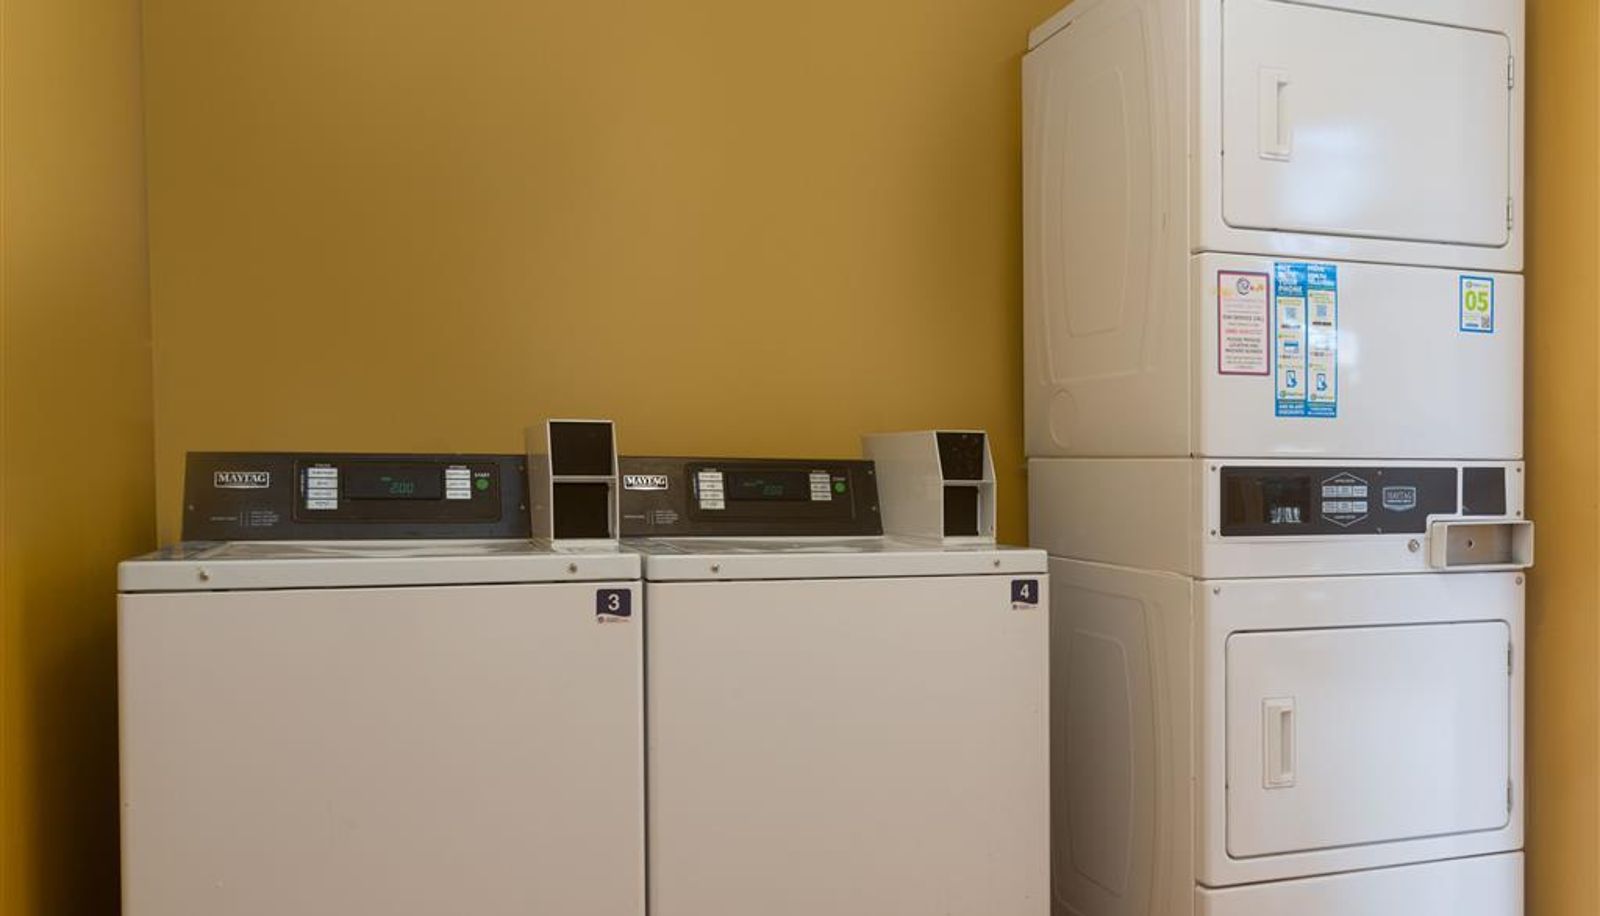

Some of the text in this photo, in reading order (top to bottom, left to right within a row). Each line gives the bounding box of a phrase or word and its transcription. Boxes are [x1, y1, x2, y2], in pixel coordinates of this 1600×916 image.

[1465, 291, 1489, 311] 05
[218, 473, 267, 483] MAYTAG
[625, 475, 666, 486] MAYTAG
[1386, 491, 1413, 500] MAYTAG
[1020, 583, 1029, 599] 4
[608, 594, 620, 610] 3
